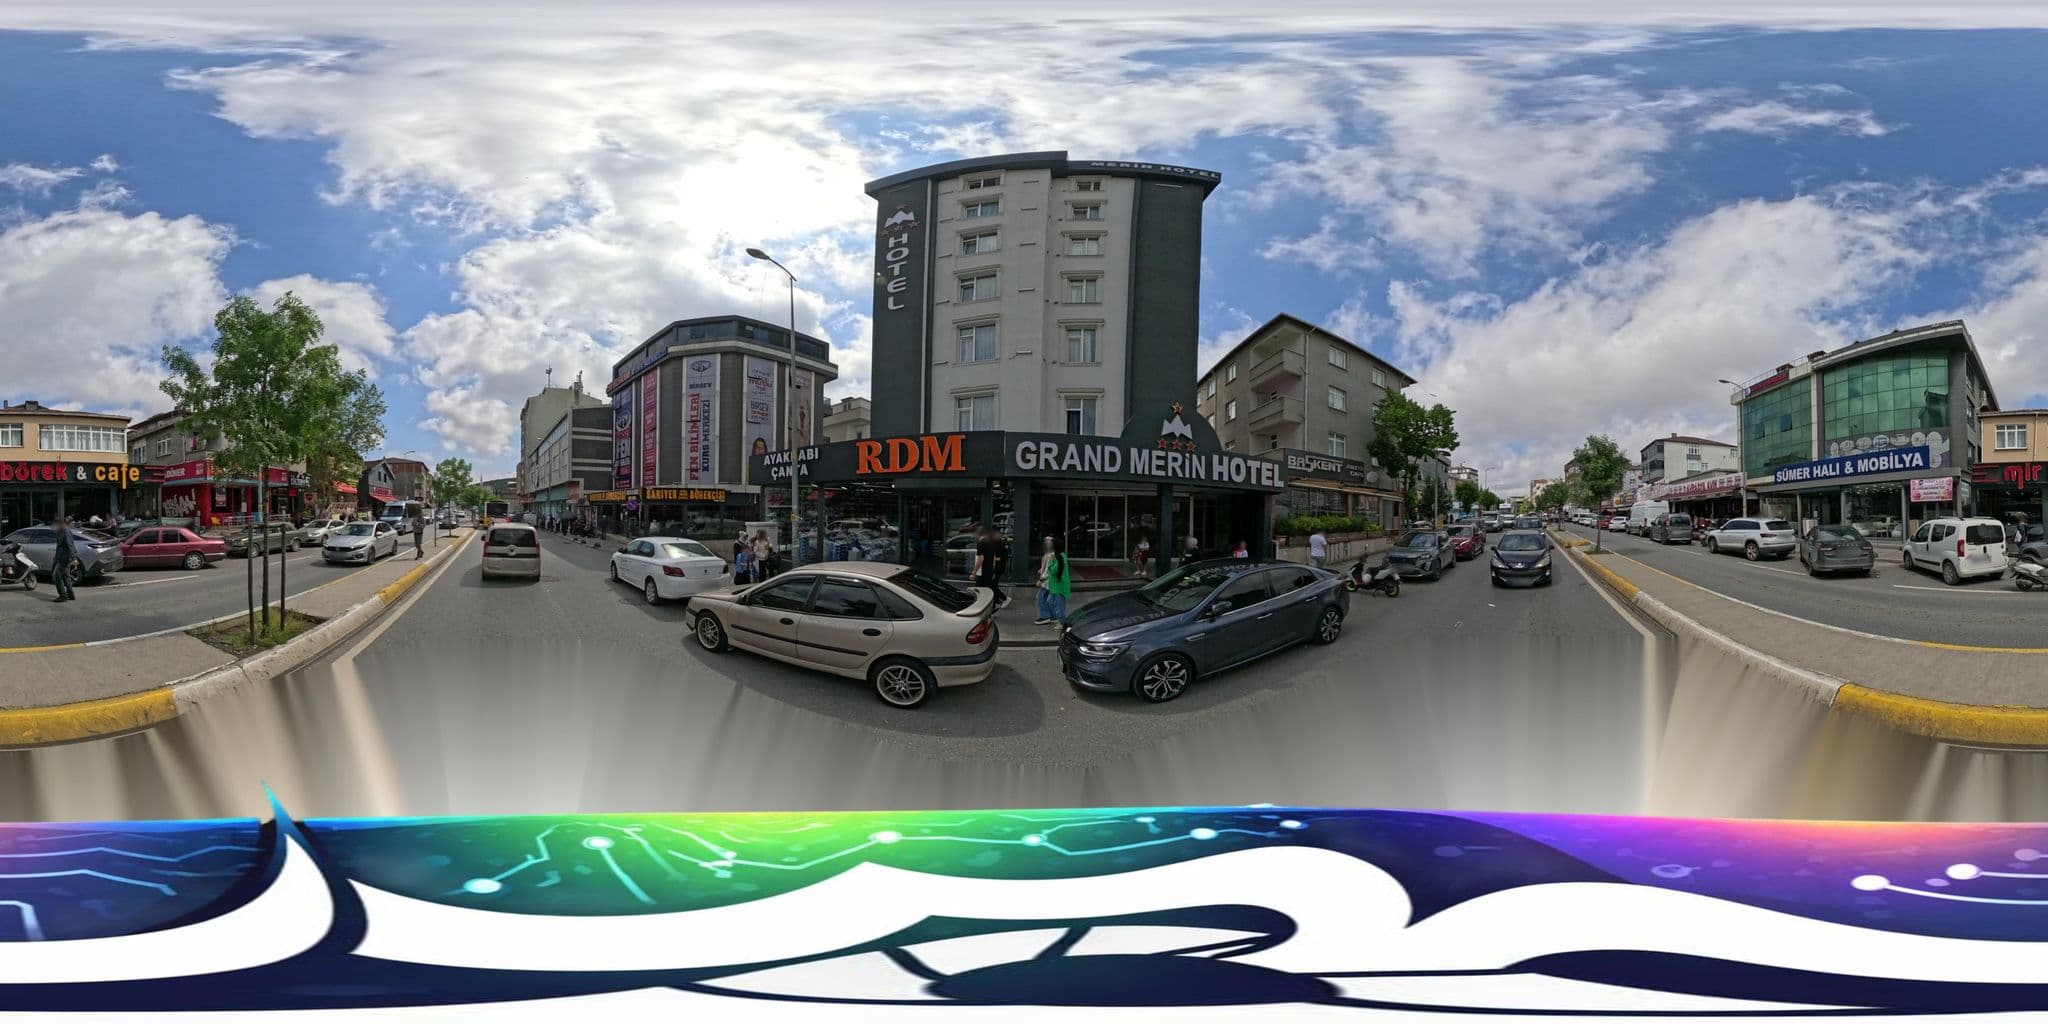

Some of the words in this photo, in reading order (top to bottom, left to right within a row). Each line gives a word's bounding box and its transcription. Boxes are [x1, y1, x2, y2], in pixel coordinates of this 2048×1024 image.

[1160, 165, 1219, 178] HOTEL
[886, 233, 908, 310] HOTEL
[701, 399, 711, 442] MERKEZİ
[689, 455, 700, 480] FEN
[701, 444, 711, 472] KURS
[763, 447, 819, 466] AYAKABI
[855, 434, 967, 475] RDM
[1015, 441, 1122, 473] GRAND
[1212, 454, 1285, 488] HOTEL
[1775, 467, 1811, 484] SÜMER
[1812, 462, 1840, 479] HALI
[1844, 460, 1855, 475] &
[1856, 450, 1924, 473] MOBİLYA
[76, 465, 87, 480] &
[95, 463, 140, 490] cafe
[770, 463, 809, 481] ÇANA
[2003, 461, 2042, 489] mir
